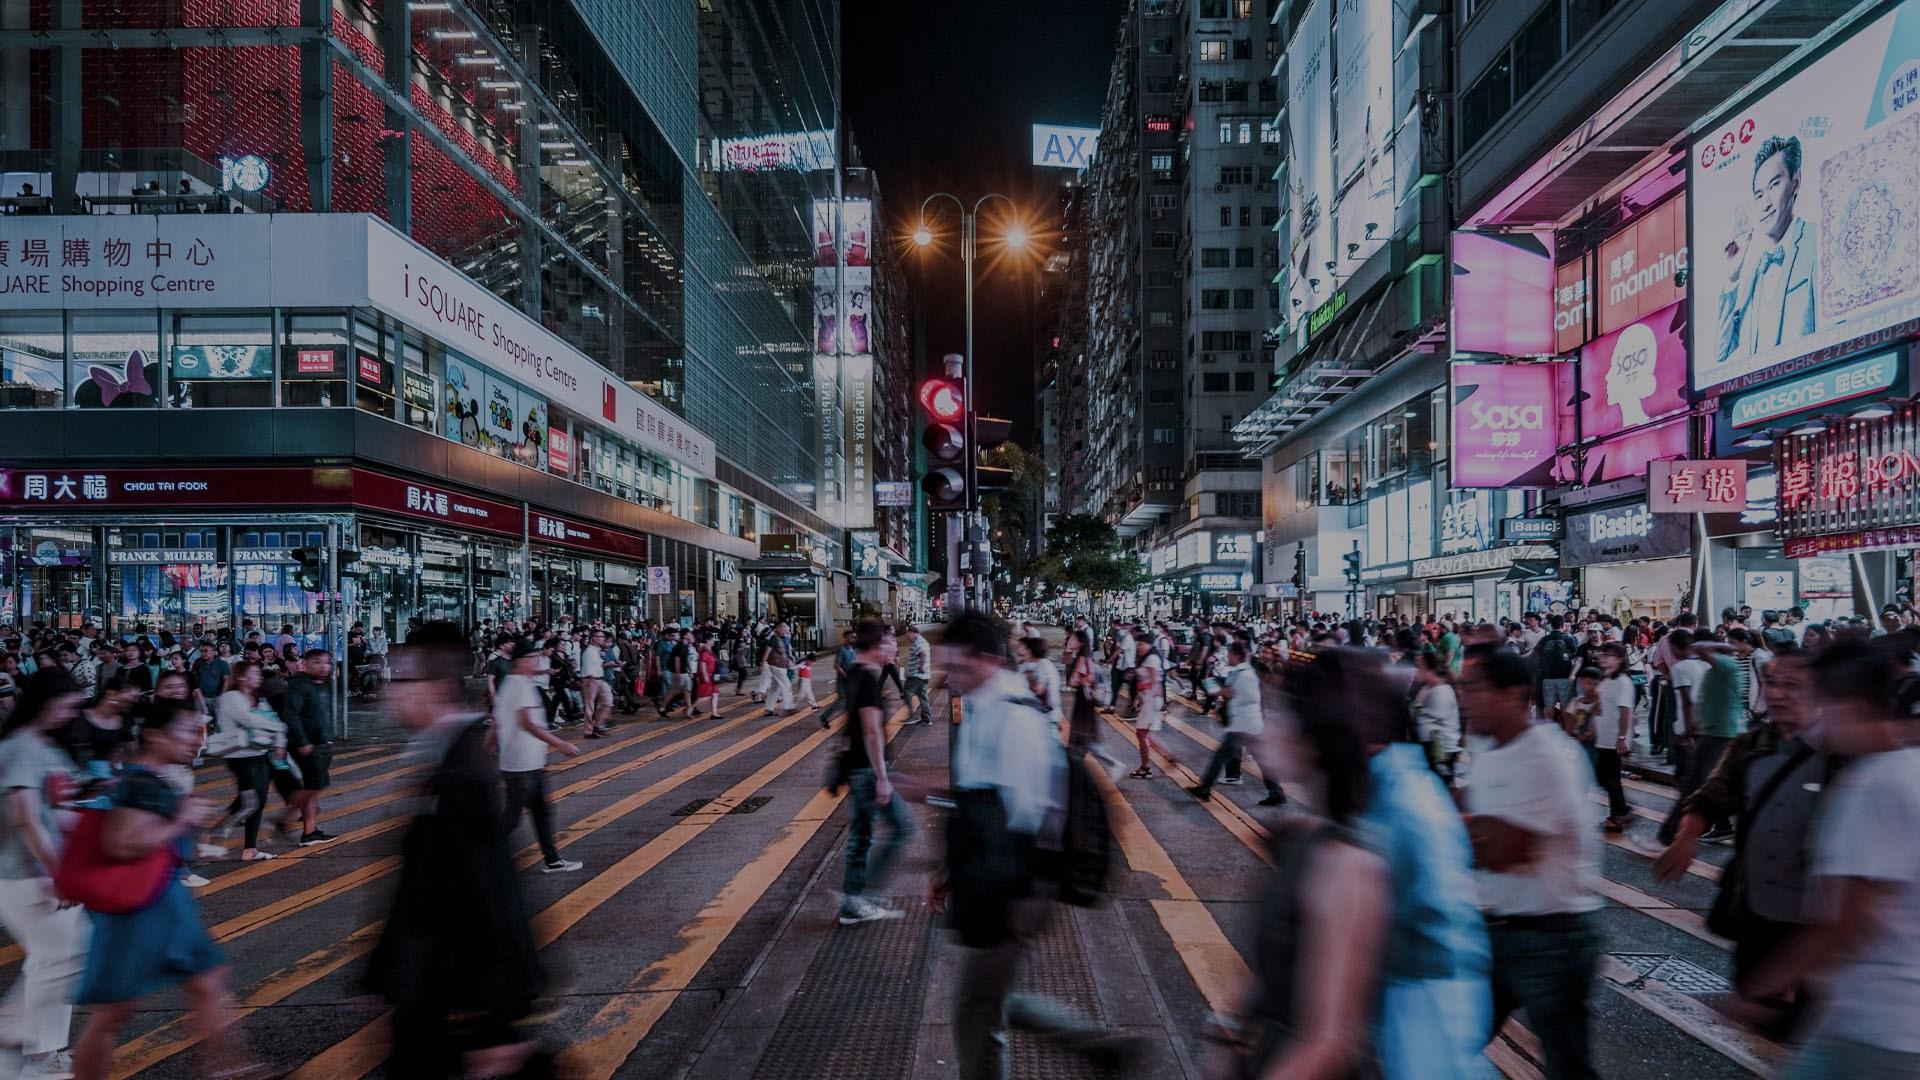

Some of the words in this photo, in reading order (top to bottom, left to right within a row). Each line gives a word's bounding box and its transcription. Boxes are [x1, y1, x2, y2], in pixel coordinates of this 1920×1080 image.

[62, 275, 145, 298] Shopping
[151, 275, 216, 293] Centre
[1310, 302, 1335, 336] Holiday
[1335, 290, 1348, 314] Inn
[418, 276, 486, 341] SQUARE
[492, 323, 543, 378] Shopping
[544, 356, 578, 392] Centre
[1719, 379, 1739, 396] JM
[1742, 353, 1817, 387] NETWORK
[1741, 381, 1826, 420] watsons
[1835, 362, 1885, 395] 屈臣氏
[855, 382, 865, 441] EMPEROR
[1699, 397, 1719, 412] JM
[24, 474, 108, 500] 周大福
[123, 481, 155, 492] CHOW
[156, 482, 175, 492] TAI
[177, 481, 208, 492] FOOK
[406, 486, 448, 517] 周大福
[538, 517, 565, 540] 周大福
[110, 550, 160, 562] FRANCK
[164, 550, 214, 562] MULLER
[234, 550, 285, 562] FRANCK
[1791, 541, 1817, 556] SALE
[721, 560, 735, 584] M&S
